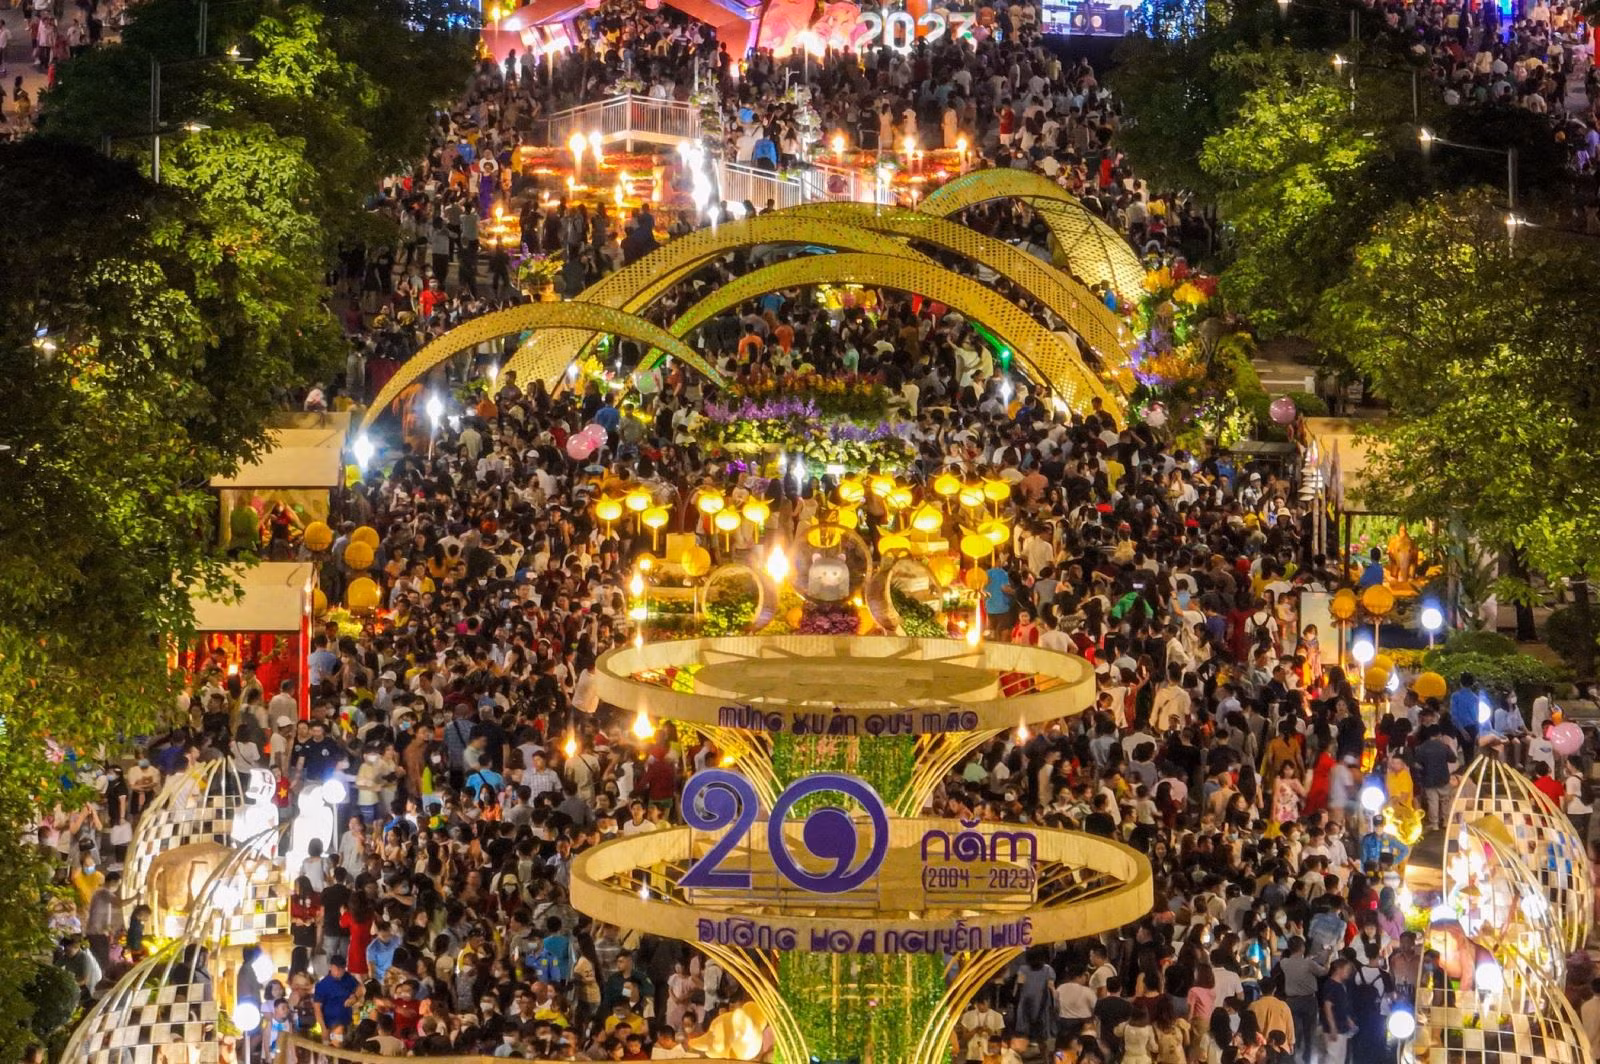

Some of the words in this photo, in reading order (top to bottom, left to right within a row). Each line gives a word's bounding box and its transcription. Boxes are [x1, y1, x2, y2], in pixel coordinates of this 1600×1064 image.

[855, 11, 977, 55] 2023
[676, 769, 889, 895] 20
[921, 864, 970, 893] (2004
[988, 864, 1037, 893] 2023)
[810, 928, 877, 954] HOA
